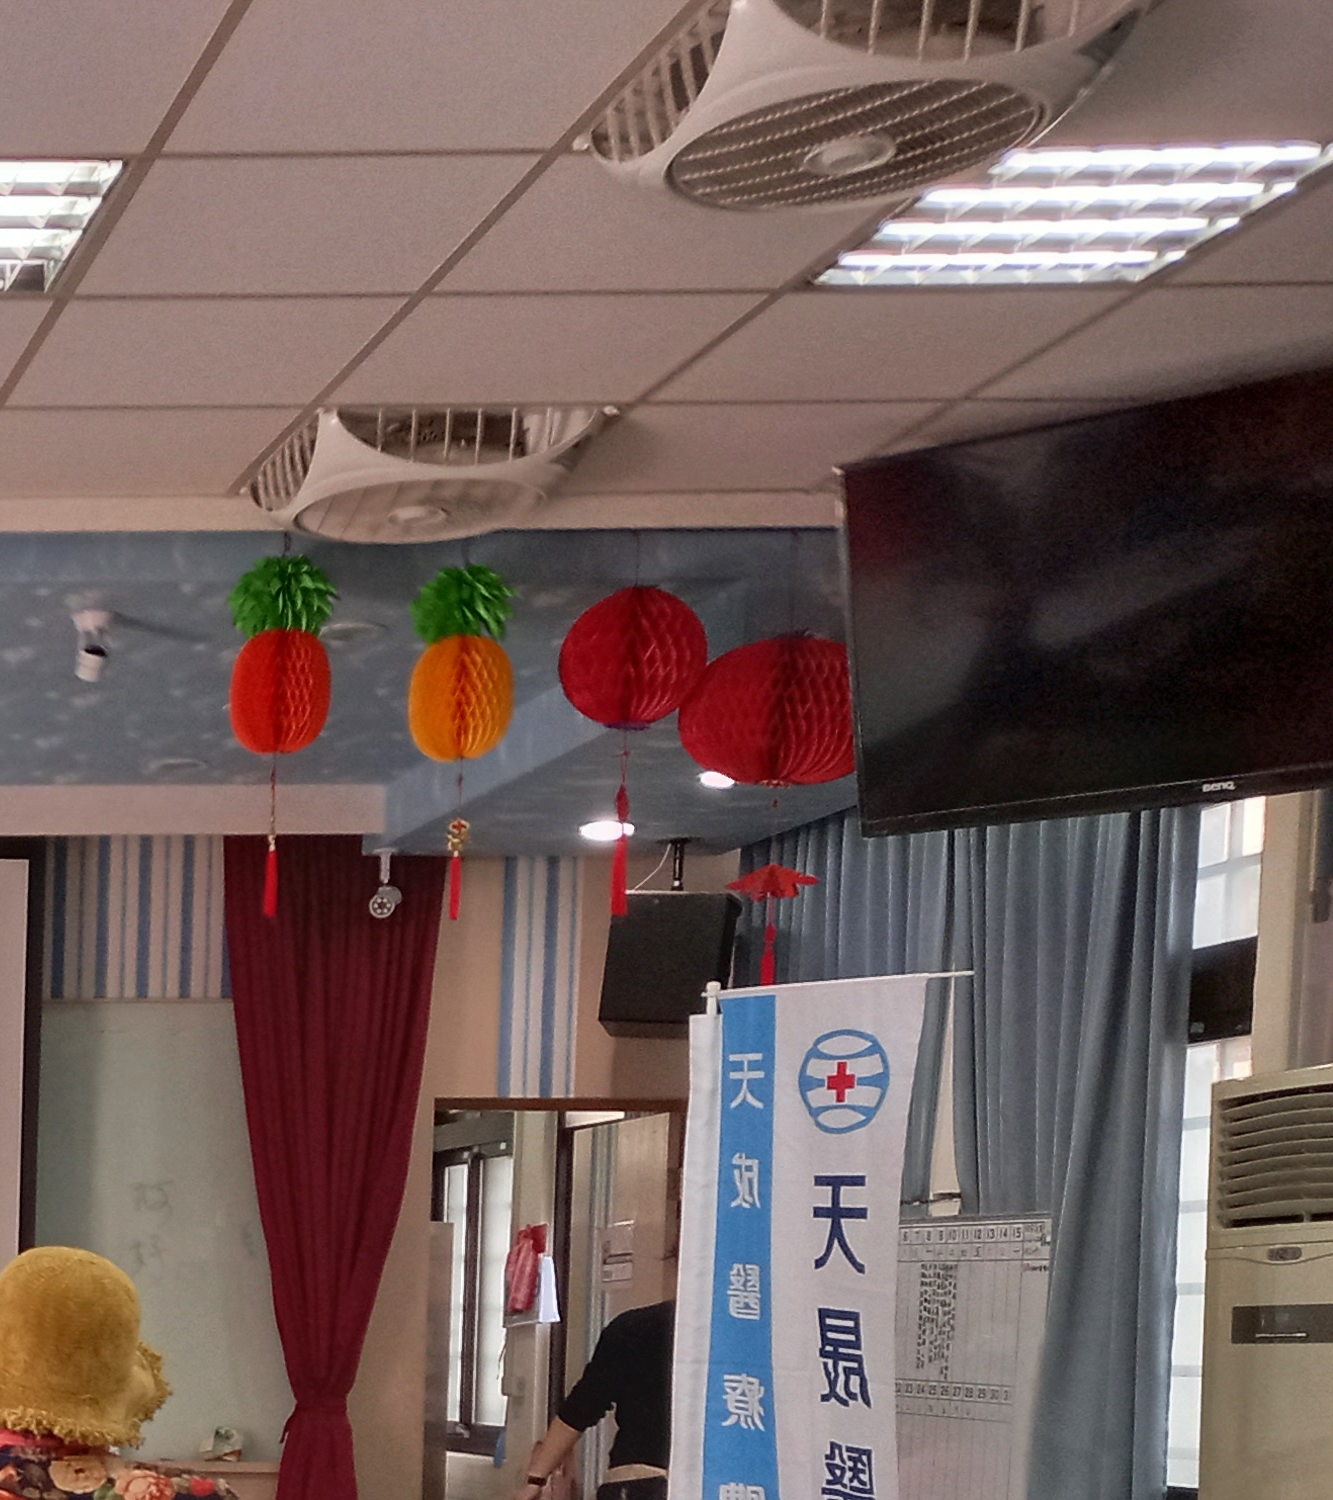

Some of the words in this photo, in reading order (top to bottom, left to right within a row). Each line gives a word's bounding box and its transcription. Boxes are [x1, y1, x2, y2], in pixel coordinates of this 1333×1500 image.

[974, 1228, 982, 1239] 12
[987, 1228, 995, 1239] 13
[999, 1228, 1008, 1238] 14
[1012, 1227, 1021, 1238] 15
